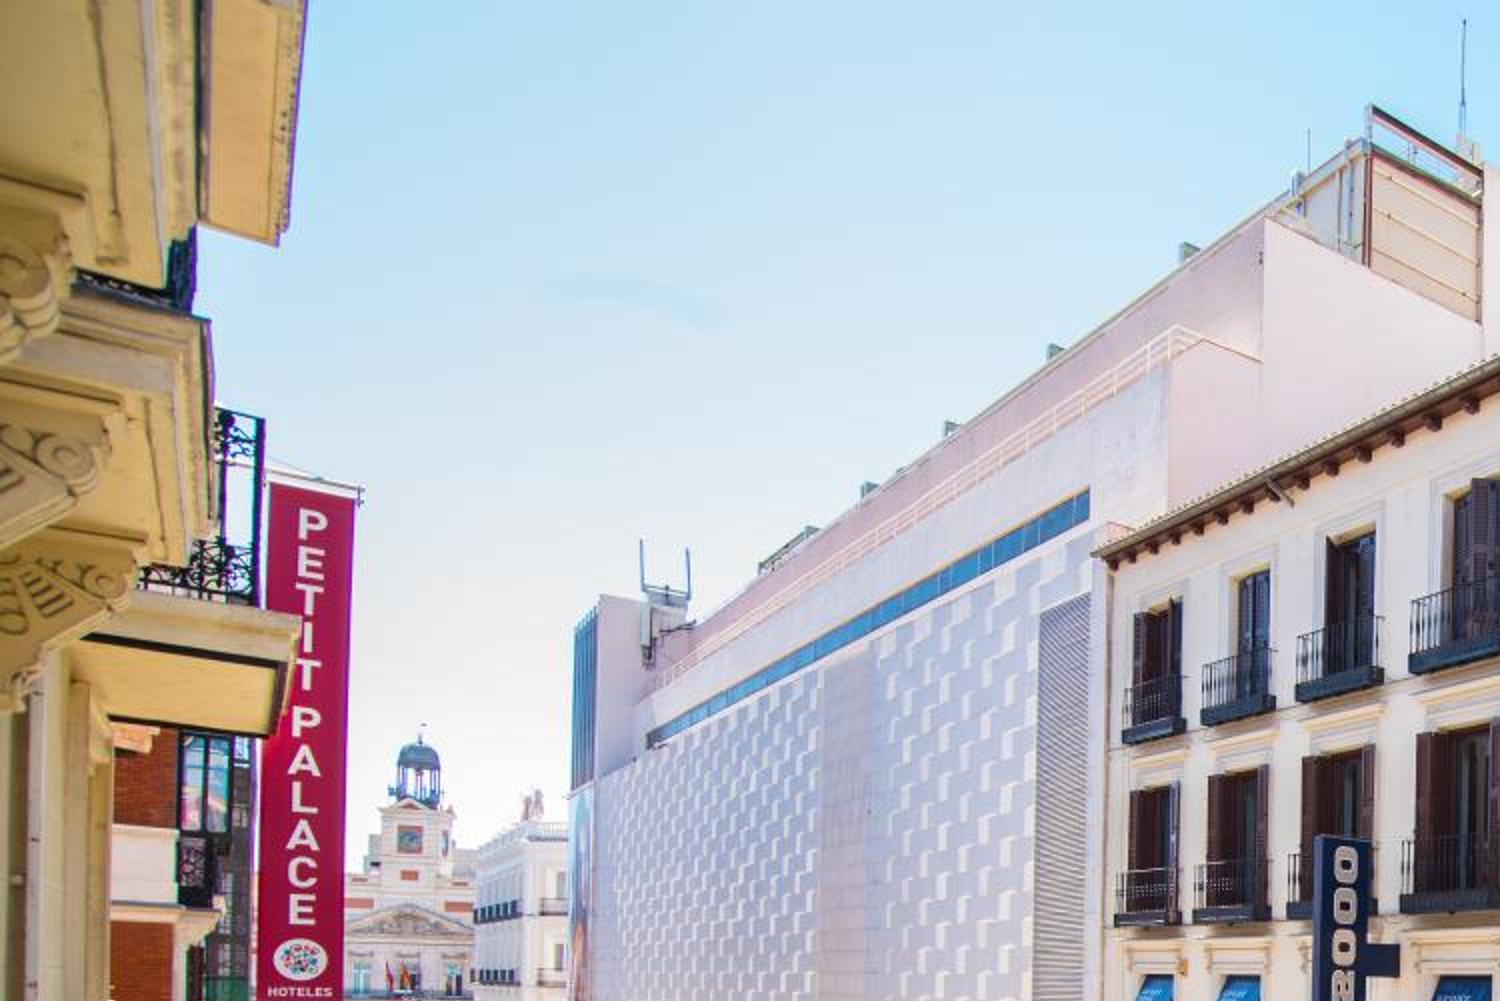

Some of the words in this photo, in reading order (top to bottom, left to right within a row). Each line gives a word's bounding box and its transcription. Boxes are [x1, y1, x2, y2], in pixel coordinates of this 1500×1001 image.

[295, 507, 329, 692] PETIT
[285, 704, 322, 926] PALACE
[267, 986, 333, 998] HOTELES
